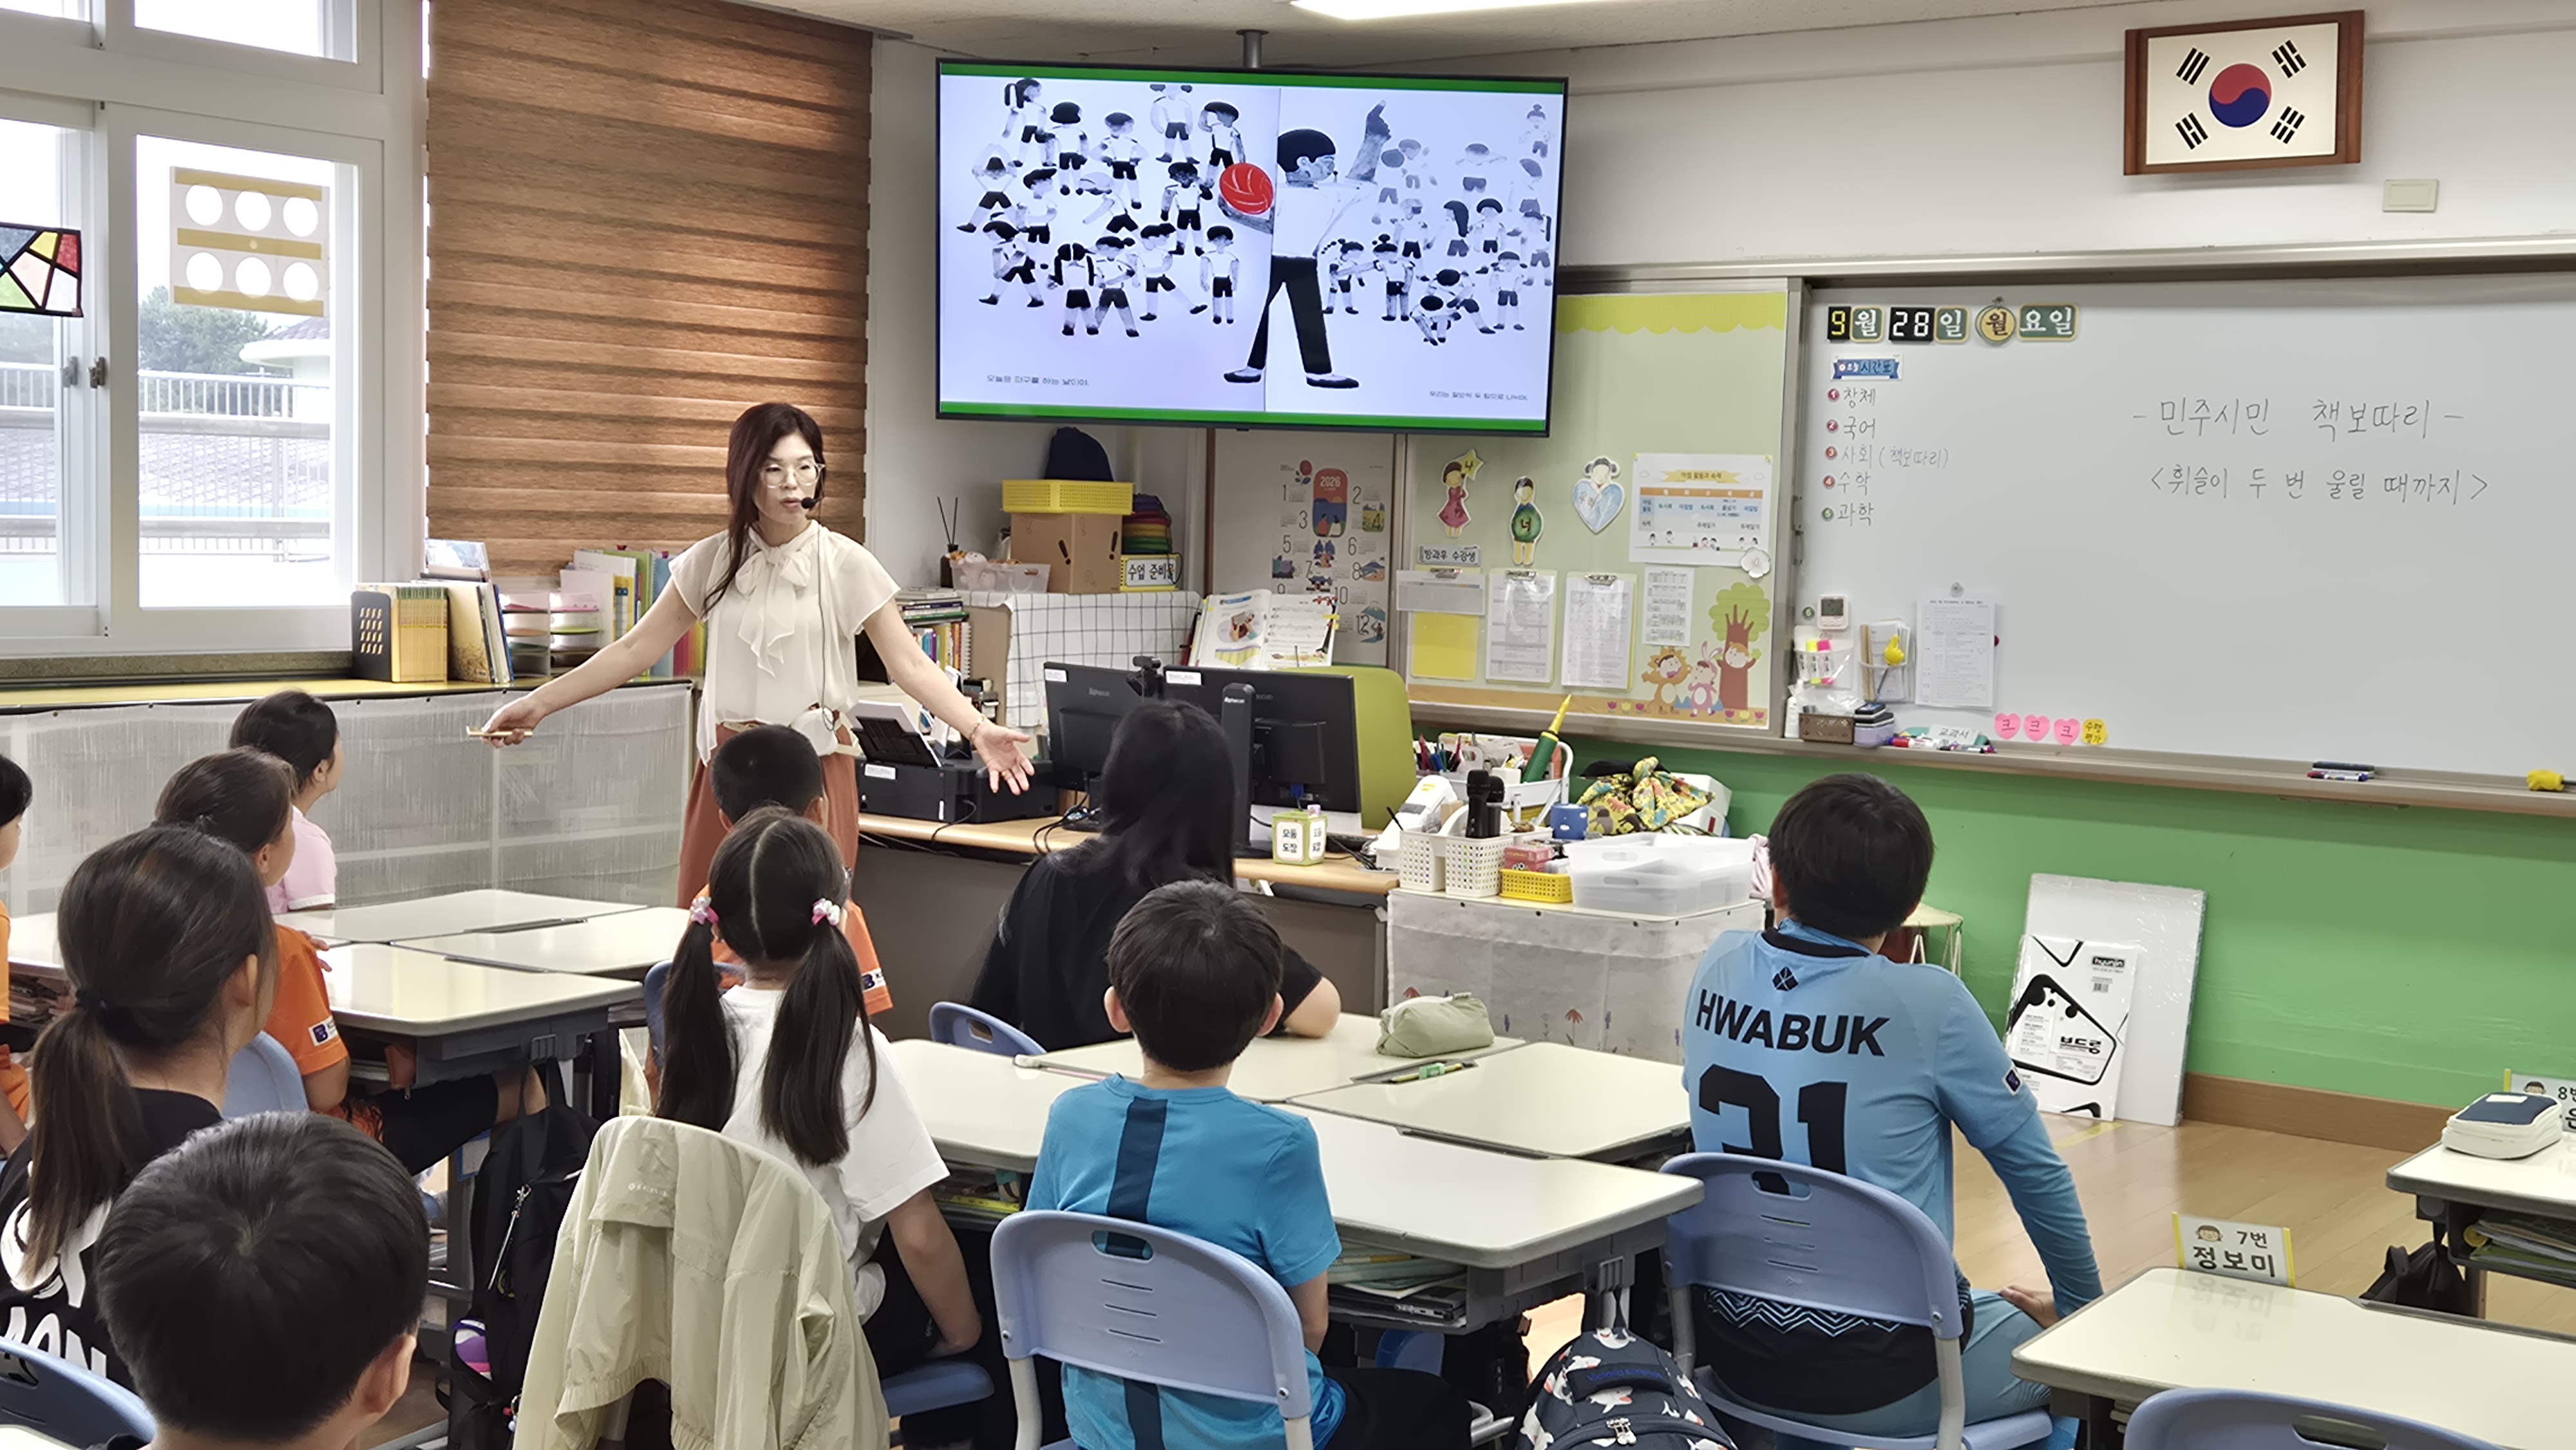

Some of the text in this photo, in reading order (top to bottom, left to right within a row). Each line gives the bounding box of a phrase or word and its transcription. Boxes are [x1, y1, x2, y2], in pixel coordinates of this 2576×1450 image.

[1861, 361, 1892, 373] 시간표
[1843, 387, 1876, 408] 창체
[1843, 416, 1876, 440] 국어
[2161, 397, 2269, 437] 민주시민
[2313, 398, 2430, 442] 책보따리
[1465, 460, 1474, 471] 나
[1841, 445, 1872, 469] 사회
[1837, 471, 1871, 496] 수학
[2249, 468, 2267, 498] 두
[2286, 469, 2304, 499] 번
[2326, 469, 2365, 500] 울릴
[1352, 486, 1361, 505] 2
[1578, 491, 1596, 509] 우리
[1299, 510, 1308, 529] 3
[1372, 513, 1381, 529] 4
[1837, 502, 1874, 527] 과학
[1520, 517, 1532, 532] 너
[1283, 535, 1291, 553] 5
[1349, 537, 1356, 556] 6
[1424, 549, 1477, 563] 방과후 수강생
[1128, 563, 1144, 580] 수업
[1305, 560, 1312, 578] 7
[1352, 562, 1361, 580] 8
[1334, 586, 1349, 605] 10
[1356, 614, 1370, 635] 12
[1938, 728, 1970, 739] 교과서
[1695, 988, 1891, 1057] HWABUK
[2237, 1230, 2268, 1249] 7번
[2193, 1246, 2275, 1278] 정보미
